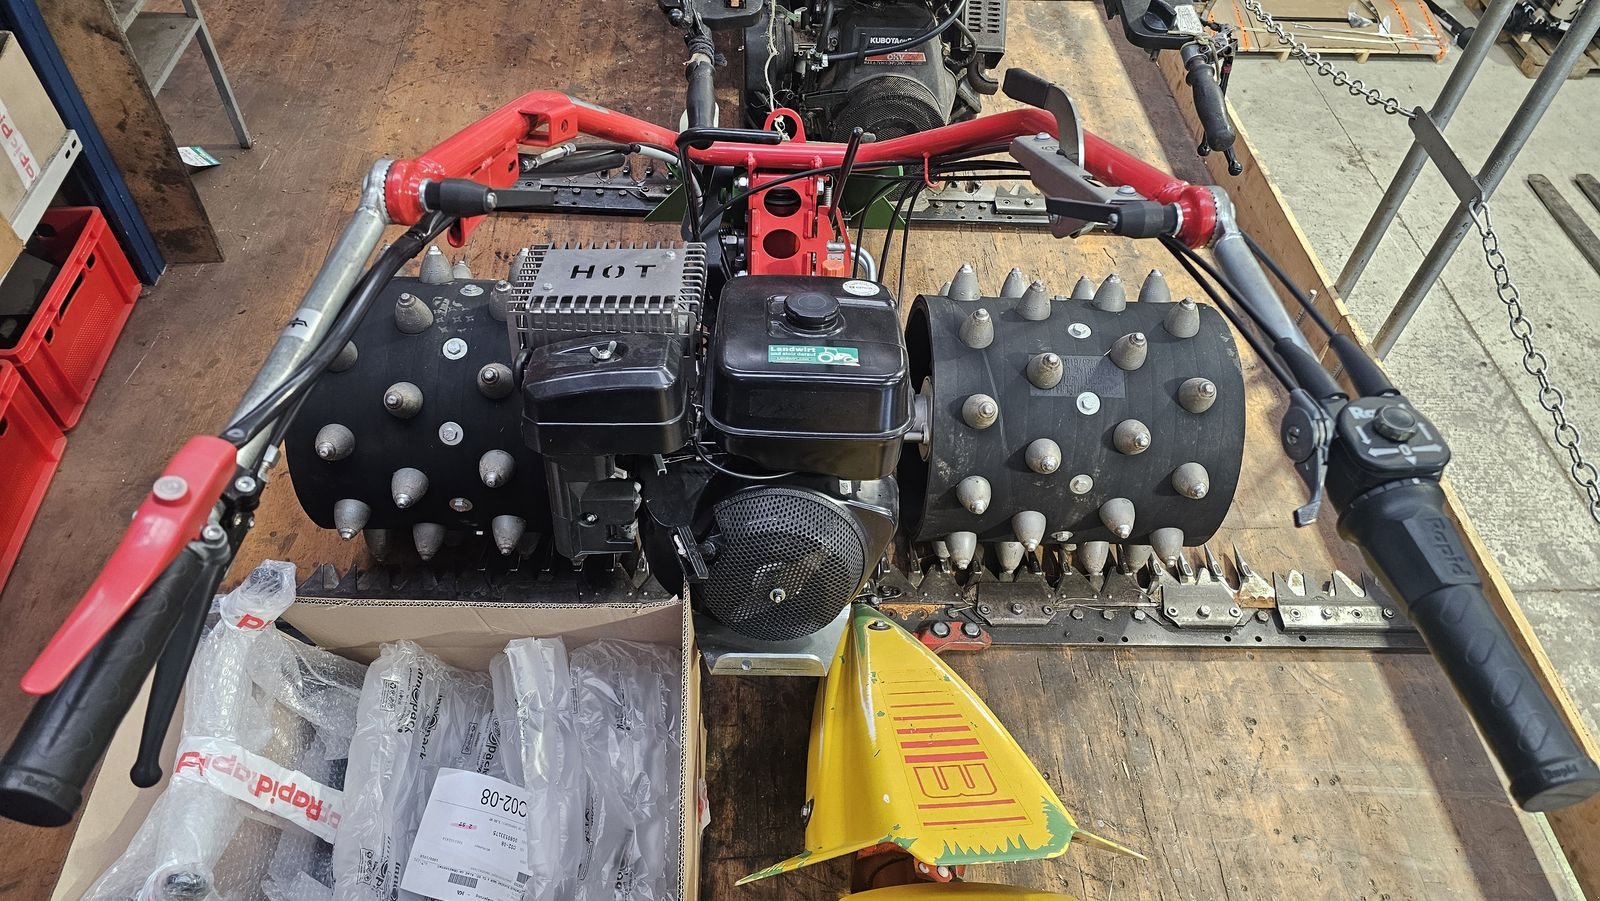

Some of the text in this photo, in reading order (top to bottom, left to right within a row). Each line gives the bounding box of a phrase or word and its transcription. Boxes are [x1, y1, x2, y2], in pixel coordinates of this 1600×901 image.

[570, 264, 657, 279] HOT
[1423, 517, 1472, 576] Rapid
[254, 773, 324, 822] Rapid
[480, 788, 527, 817] C02-08
